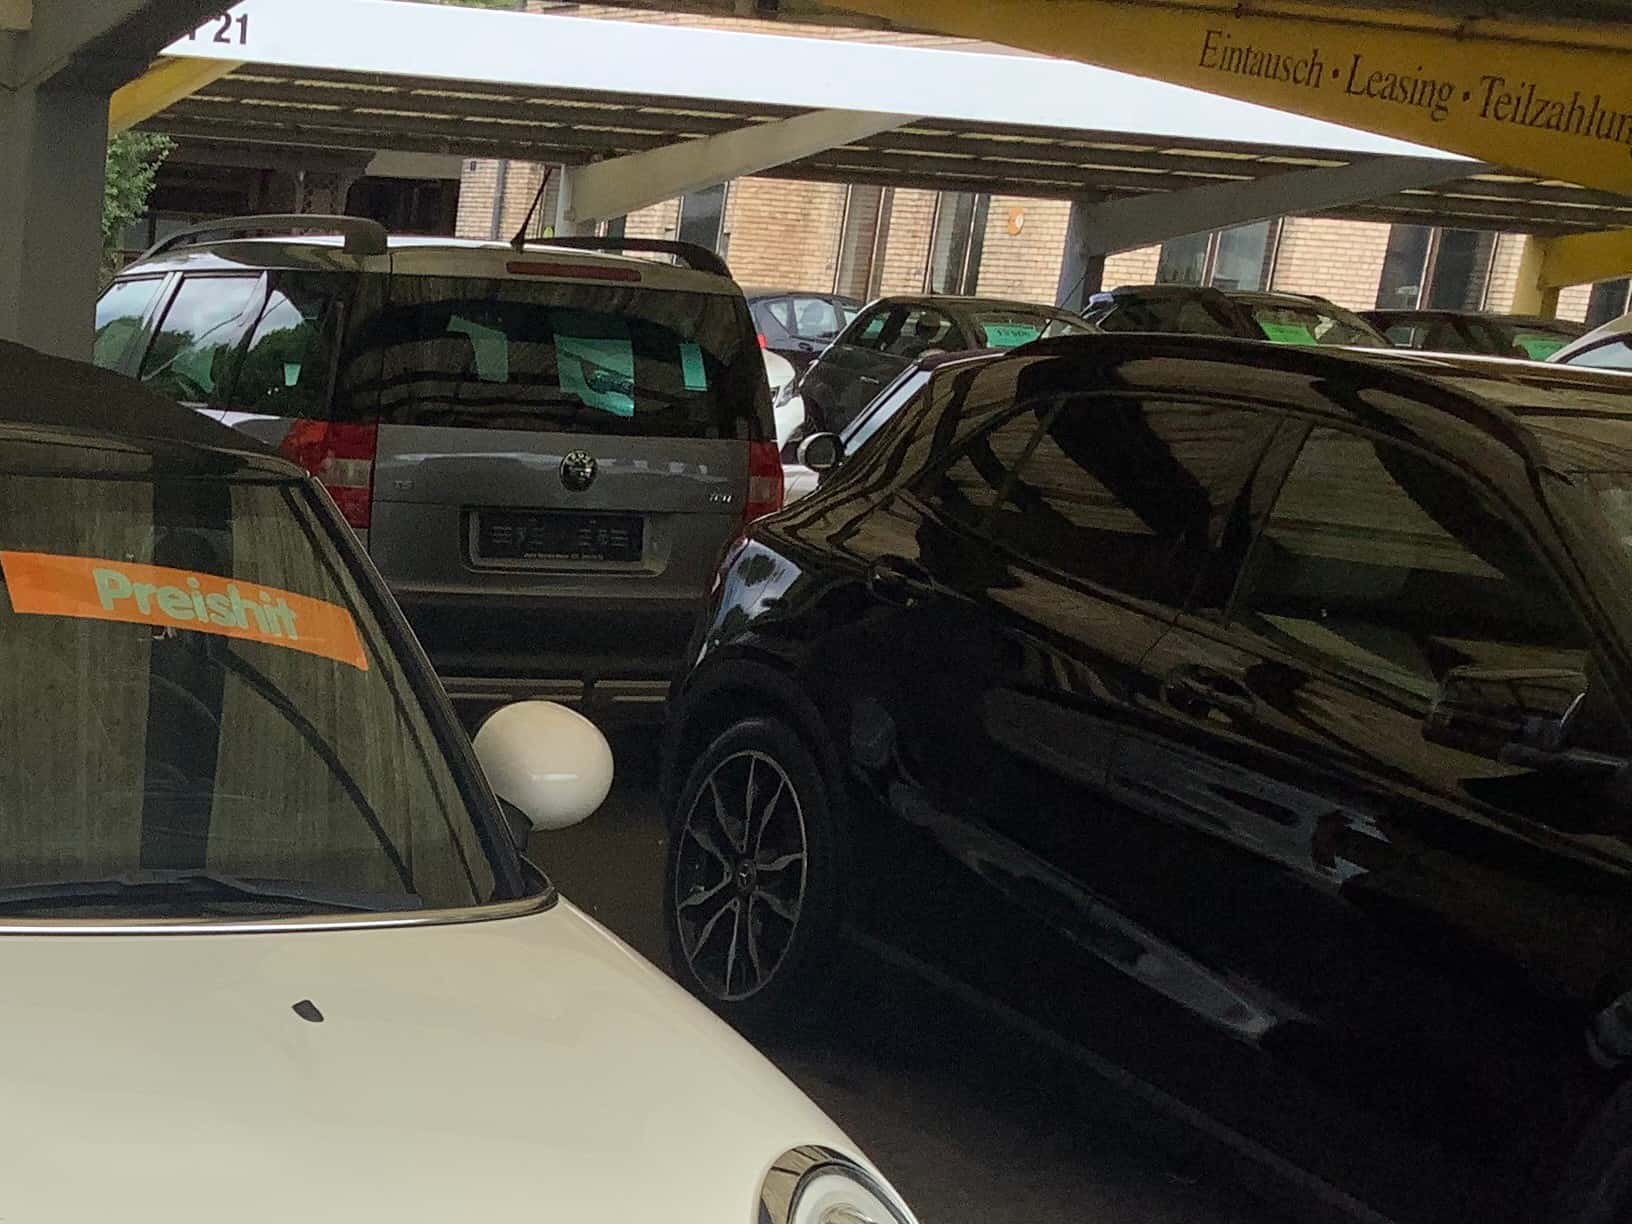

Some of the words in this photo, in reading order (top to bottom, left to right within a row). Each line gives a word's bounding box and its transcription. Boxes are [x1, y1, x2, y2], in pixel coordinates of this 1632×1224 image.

[213, 13, 248, 45] 21
[1199, 29, 1324, 88] Eintausch
[1344, 54, 1456, 122] Leasing
[1479, 74, 1632, 160] Teilzahlun
[92, 567, 297, 640] Preishit
